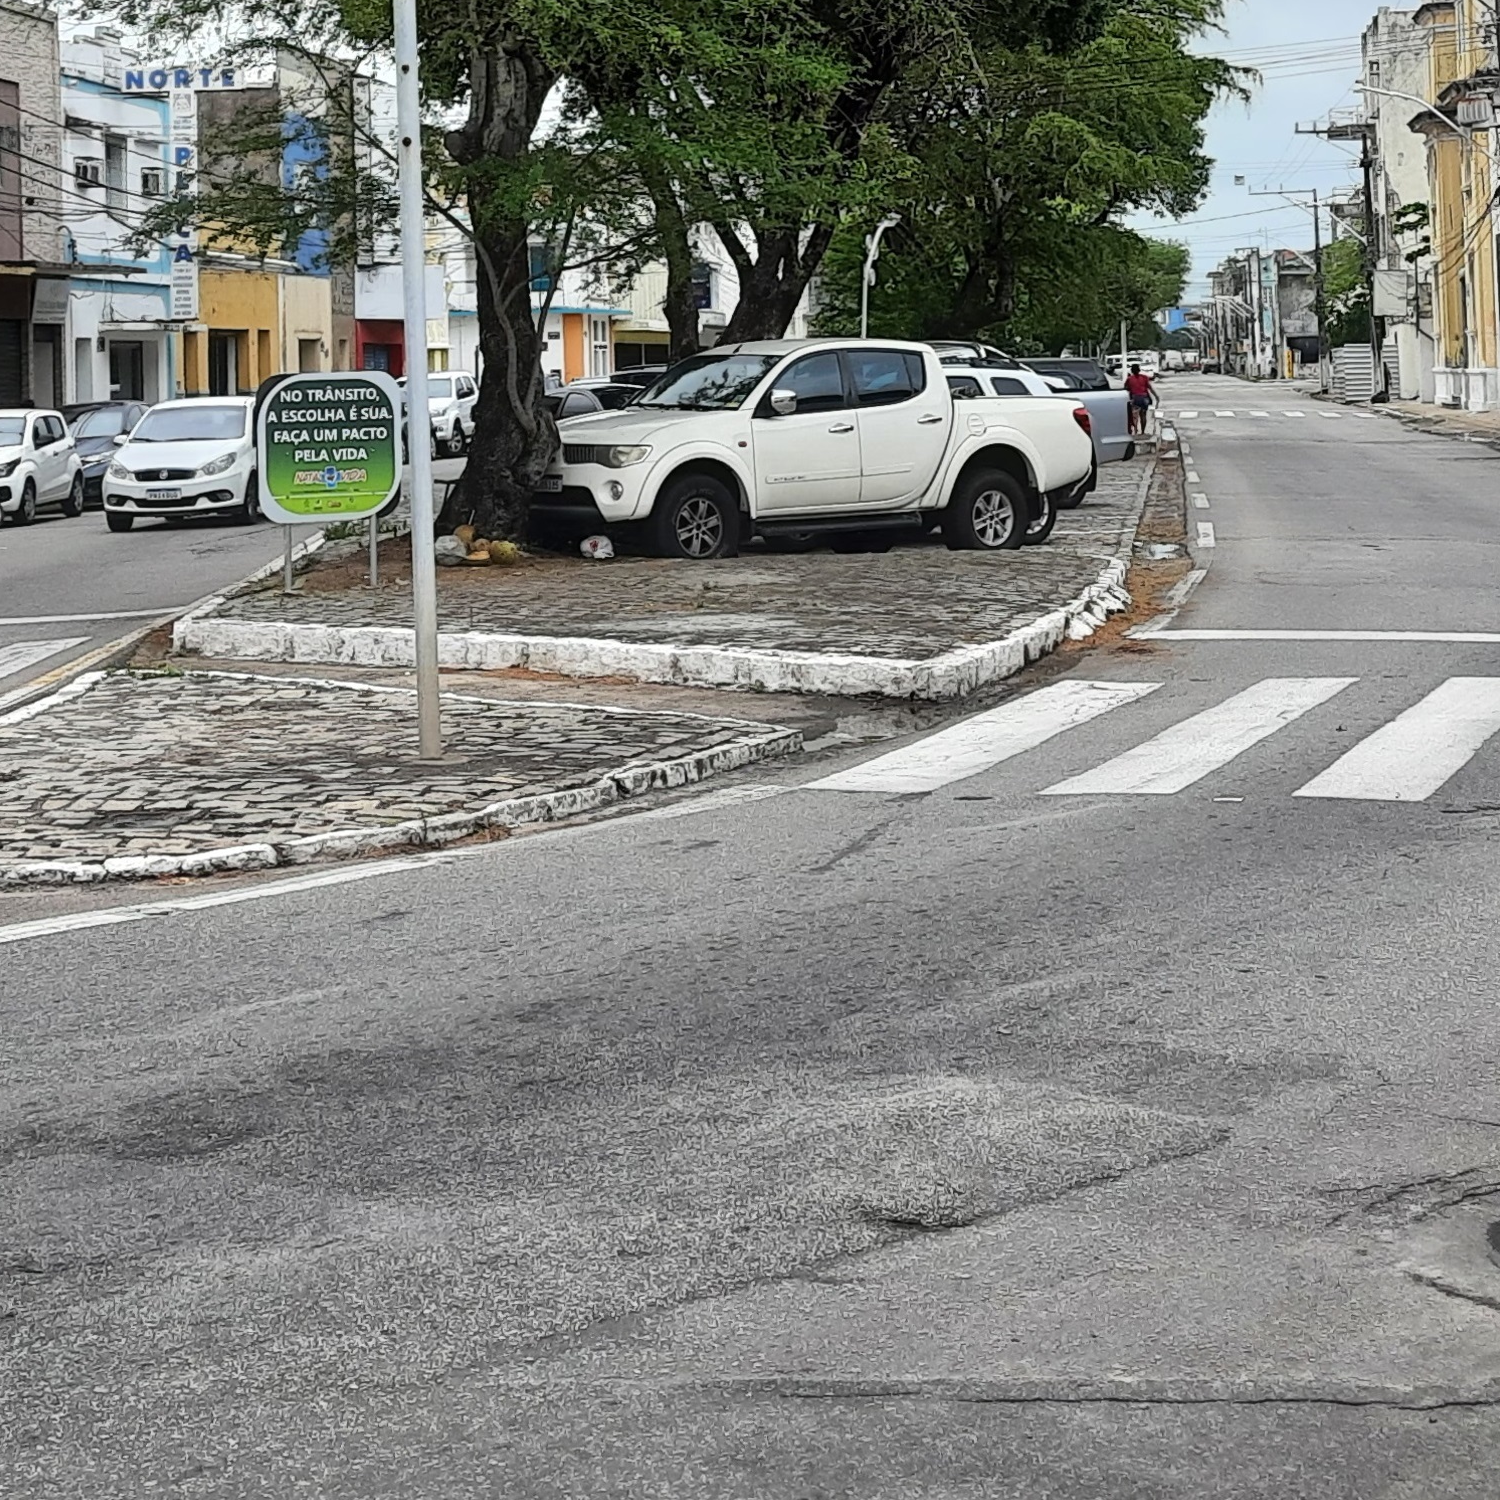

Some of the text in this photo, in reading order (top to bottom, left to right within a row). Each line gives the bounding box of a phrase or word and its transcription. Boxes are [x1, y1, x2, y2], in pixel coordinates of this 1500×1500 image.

[125, 68, 236, 90] NORTE
[280, 385, 380, 403] NO TRÂNSITO,
[267, 404, 393, 423] A ESCOLHA É SUA.
[273, 427, 387, 445] FAÇA UM PACTO
[294, 448, 368, 463] PELA VIDA
